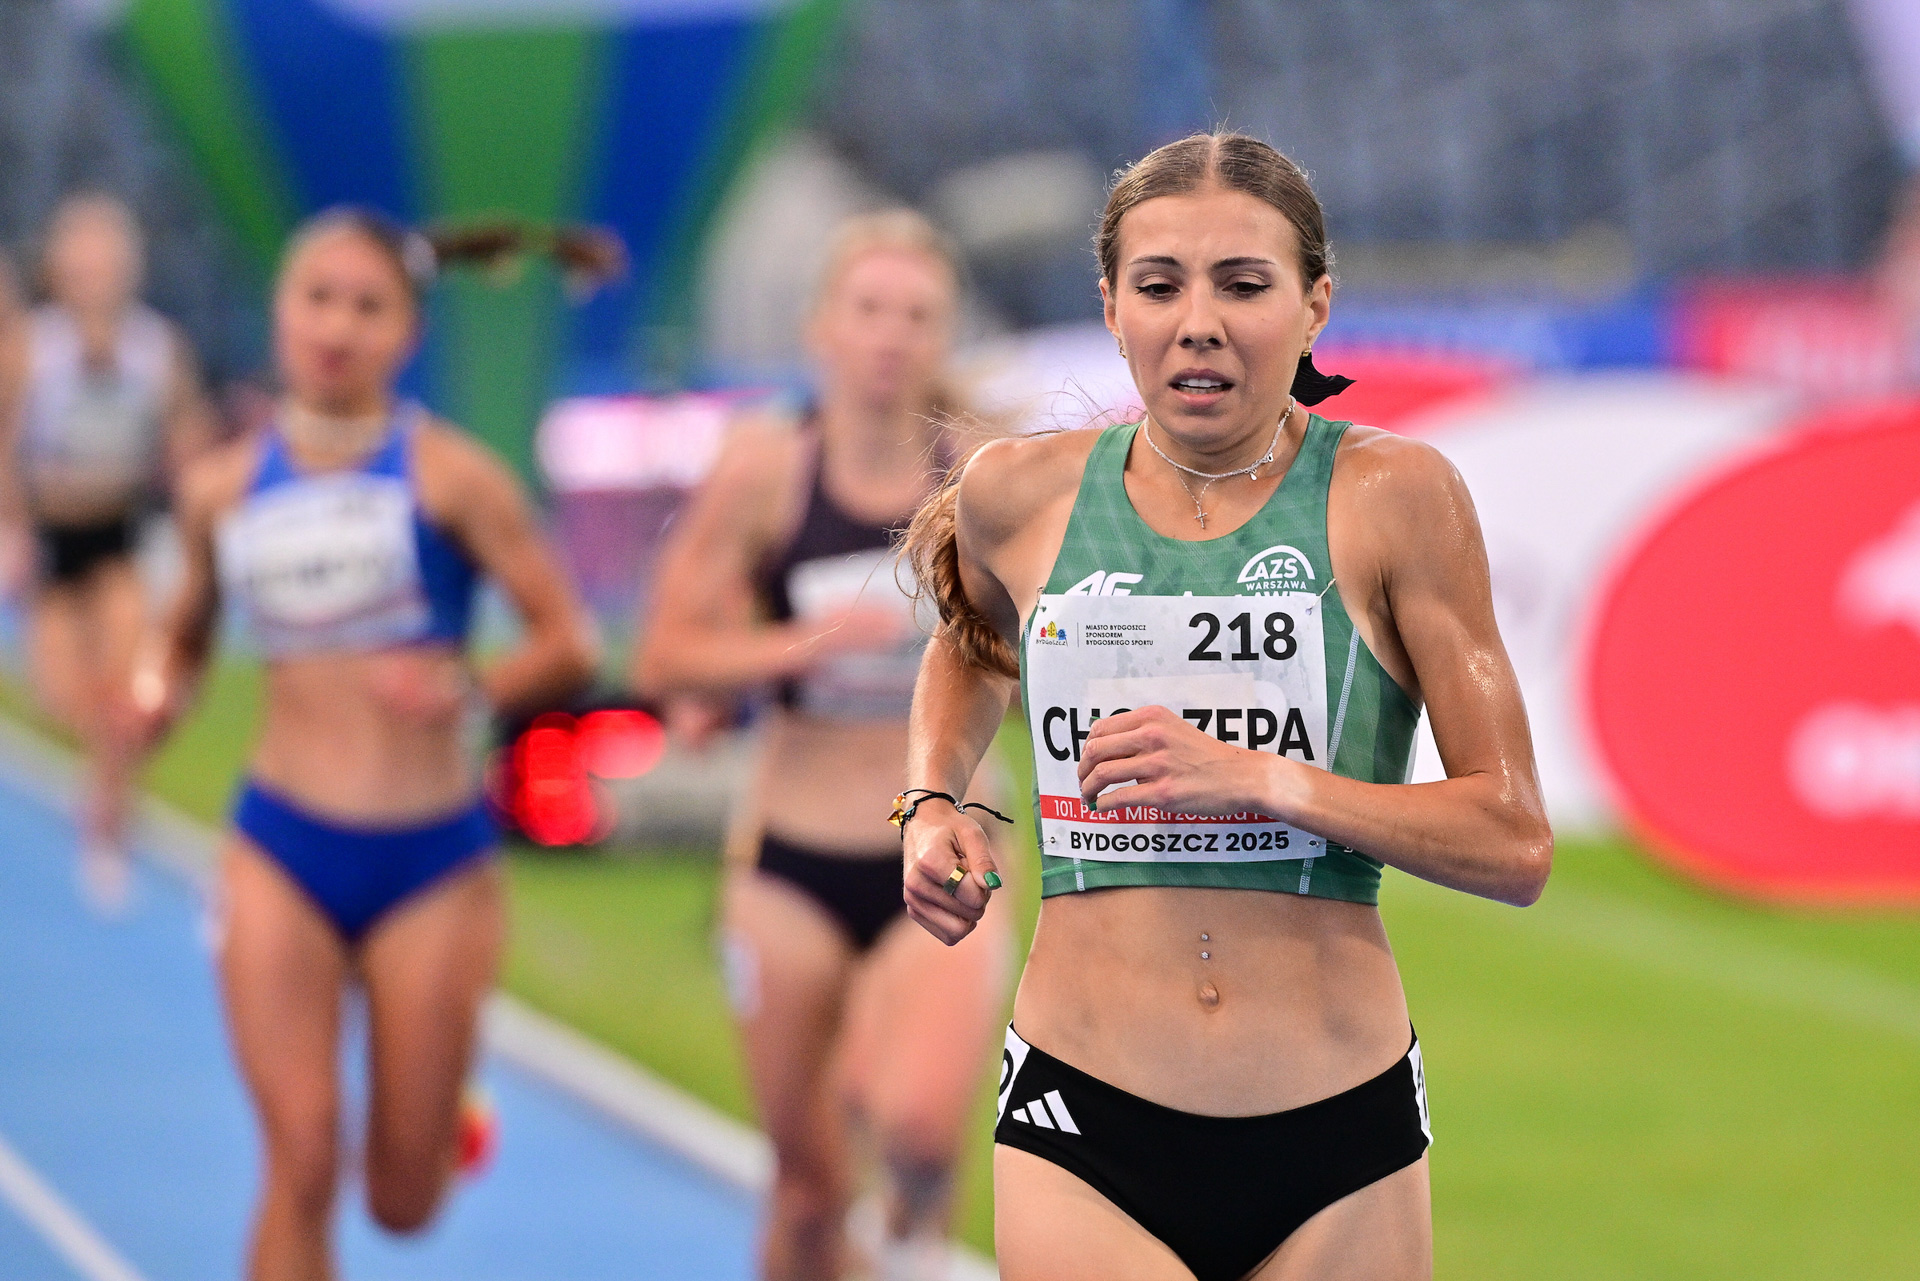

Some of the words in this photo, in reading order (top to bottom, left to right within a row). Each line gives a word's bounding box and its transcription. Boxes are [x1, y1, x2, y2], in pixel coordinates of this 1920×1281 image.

[1253, 558, 1298, 579] AZS
[1245, 580, 1307, 591] WARSZAWA
[1188, 611, 1298, 661] 218
[1054, 799, 1077, 818] 101.
[1070, 831, 1219, 852] BYDGOSZCZ
[1225, 831, 1290, 852] 2025
